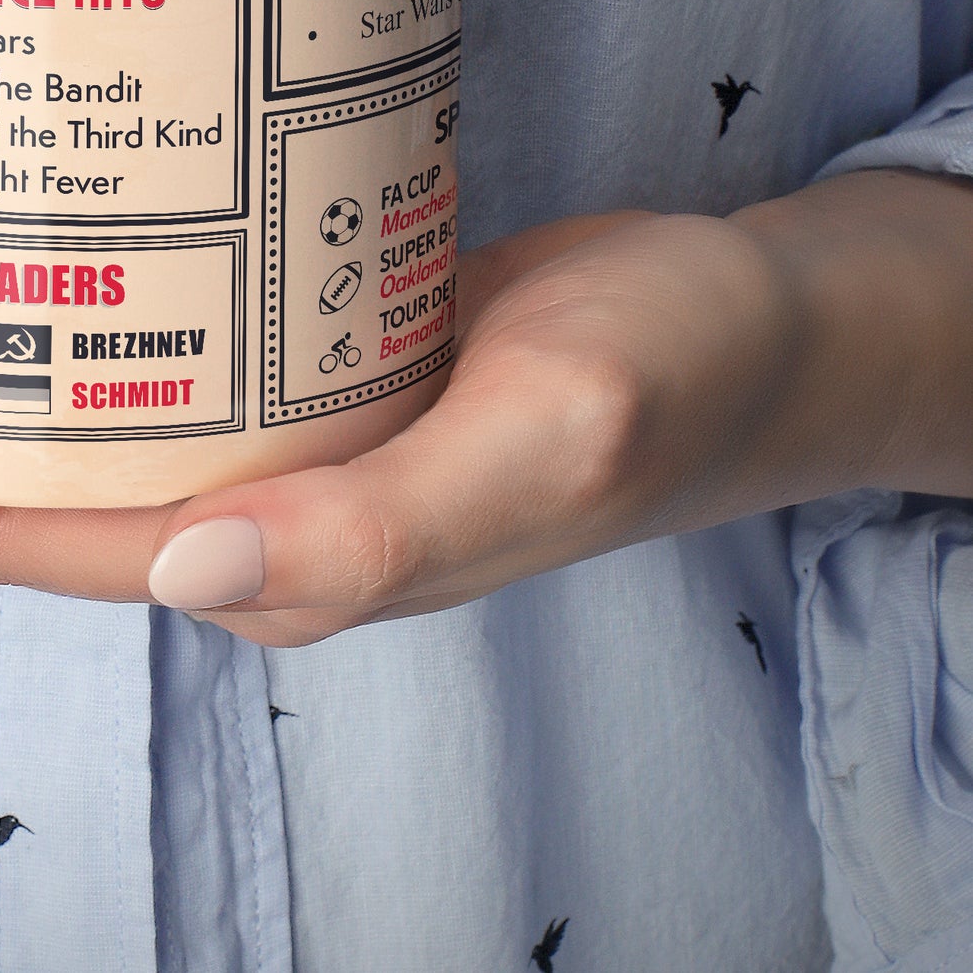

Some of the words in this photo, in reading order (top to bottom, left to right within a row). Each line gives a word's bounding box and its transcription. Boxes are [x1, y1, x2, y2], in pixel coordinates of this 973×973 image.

[360, 8, 405, 40] Star
[45, 70, 143, 103] Bandit
[9, 115, 57, 149] the
[66, 118, 144, 150] Third
[156, 112, 223, 148] Kind
[41, 165, 125, 195] Fever
[381, 182, 403, 211] FA
[407, 164, 441, 199] CUP
[379, 229, 436, 273] SUPER
[380, 243, 449, 299] Oakland
[379, 293, 429, 333] TOUR
[432, 278, 449, 309] DE
[71, 328, 206, 360] BREZHNEV
[379, 305, 444, 361] Bernard
[71, 378, 195, 409] SCHMIDT
